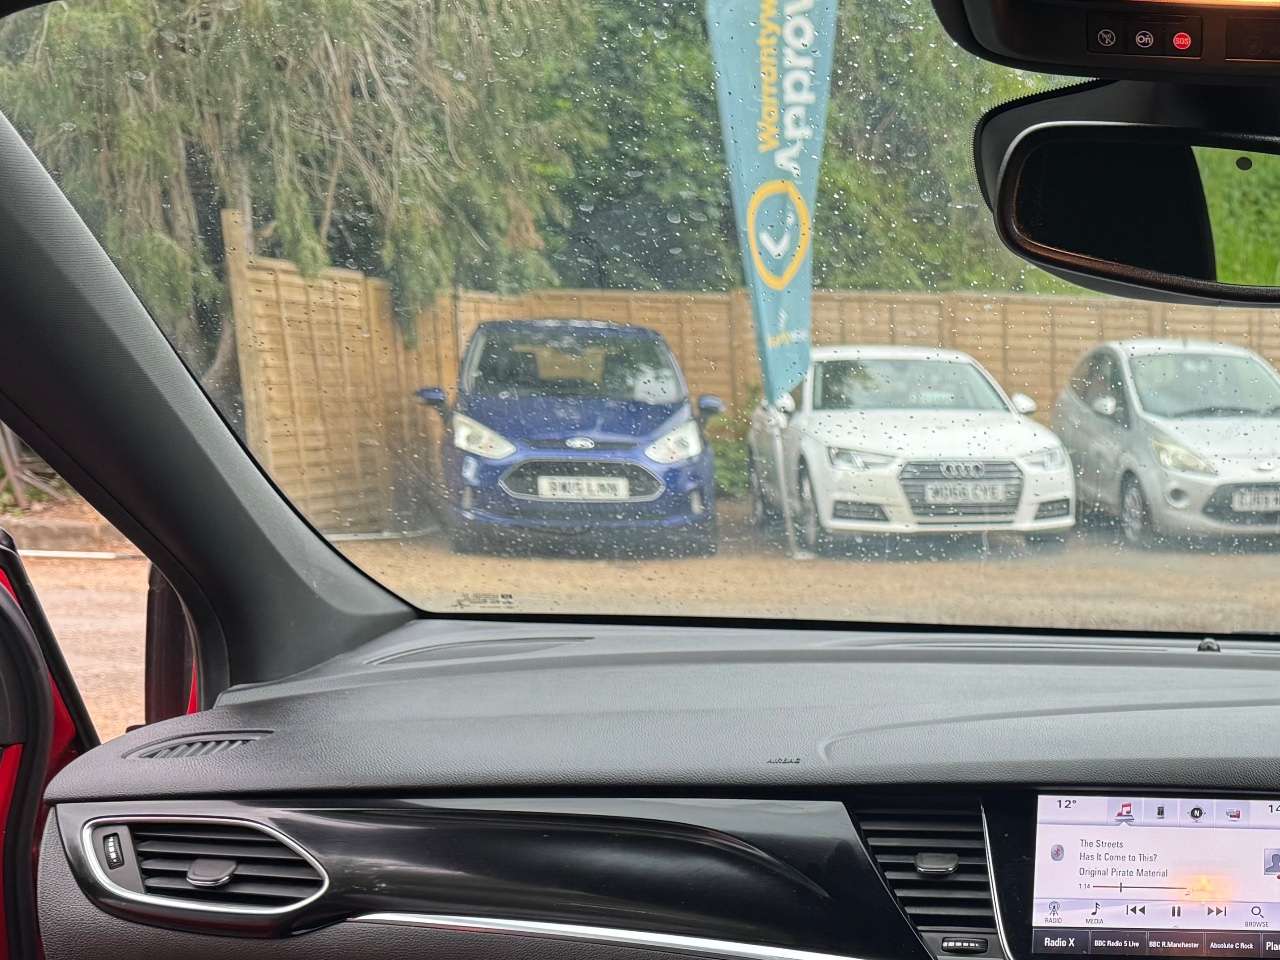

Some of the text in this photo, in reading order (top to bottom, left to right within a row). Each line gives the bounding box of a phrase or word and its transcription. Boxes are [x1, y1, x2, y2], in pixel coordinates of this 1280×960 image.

[1175, 36, 1189, 44] SOS
[1080, 839, 1124, 849] The Streets
[1080, 853, 1095, 861] Has
[1104, 853, 1126, 862] Come
[1139, 854, 1158, 862] This?
[1079, 868, 1168, 878] Original Pirate Material
[1044, 937, 1075, 947] Radio X
[1107, 940, 1122, 948] Radio
[1129, 940, 1140, 948] Live
[1210, 942, 1234, 950] Absolute
